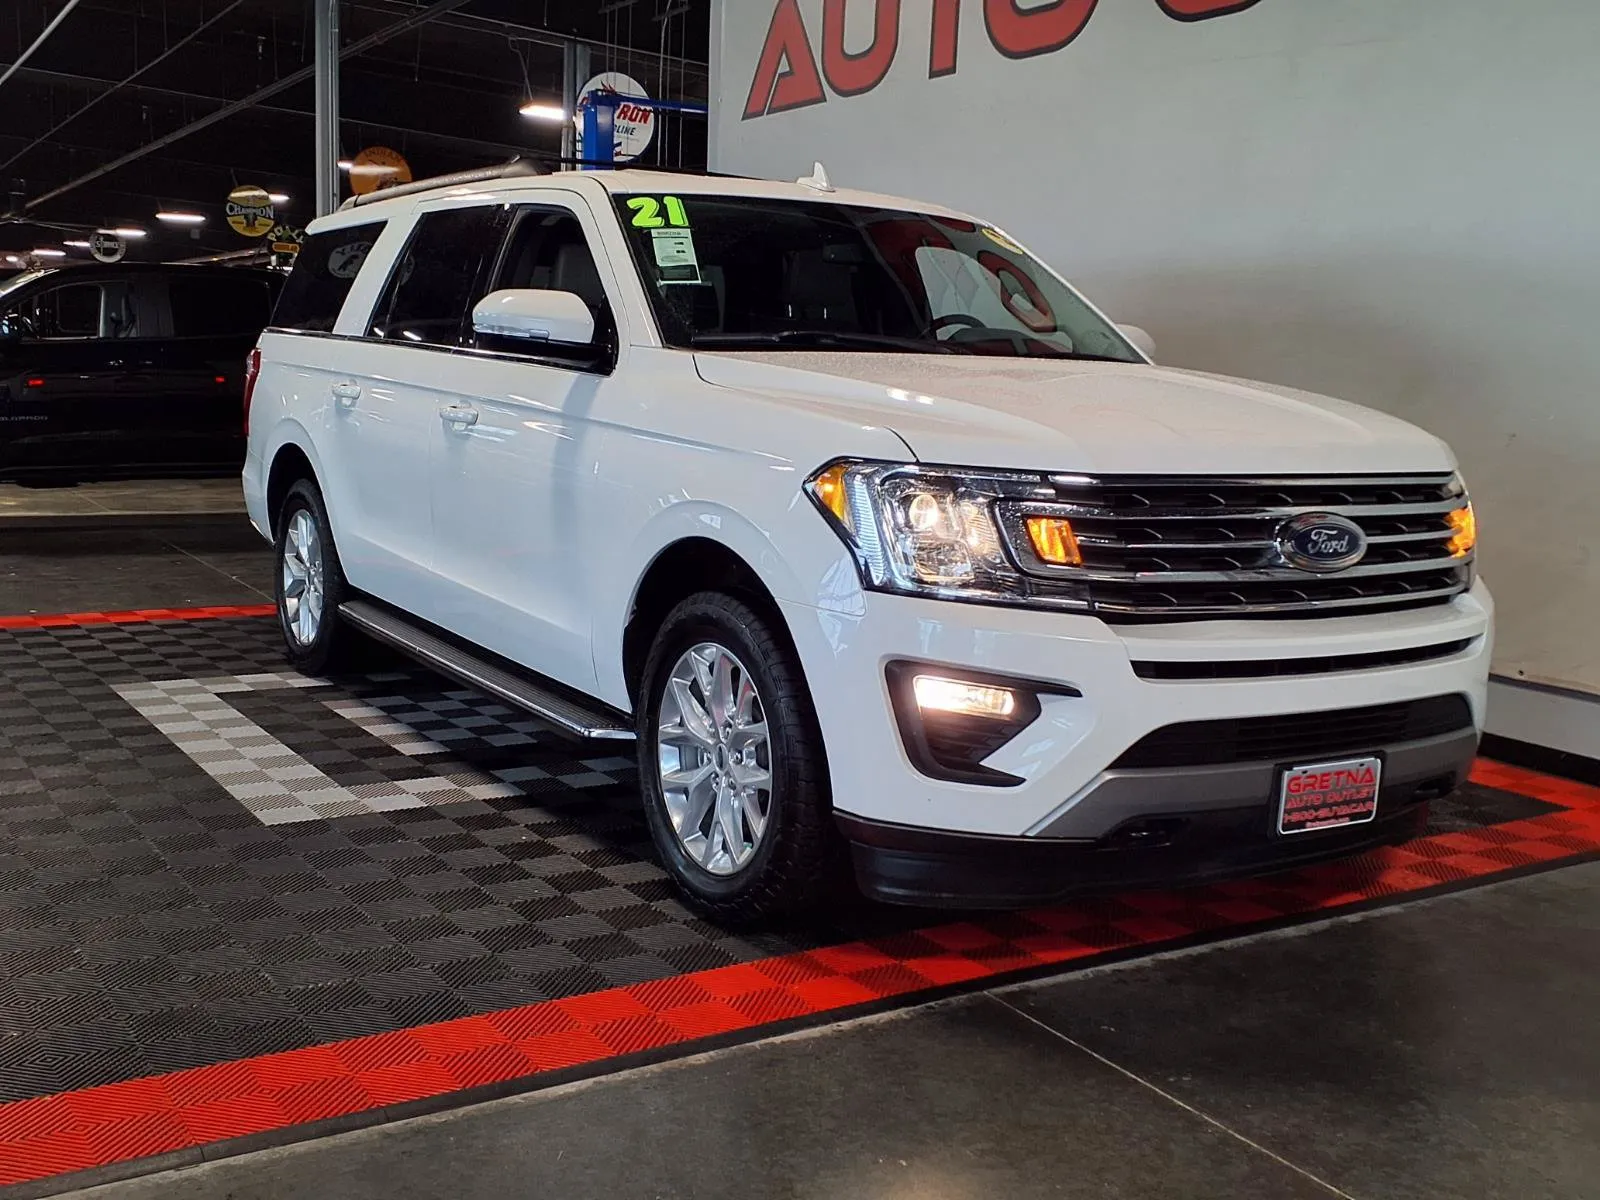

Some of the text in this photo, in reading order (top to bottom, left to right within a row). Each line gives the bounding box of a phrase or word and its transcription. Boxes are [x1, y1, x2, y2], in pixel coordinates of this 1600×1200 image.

[626, 196, 689, 227] 21
[1307, 529, 1349, 554] Ford
[1287, 767, 1376, 794] GRETNA
[1285, 788, 1375, 809] AUTO OUTLET
